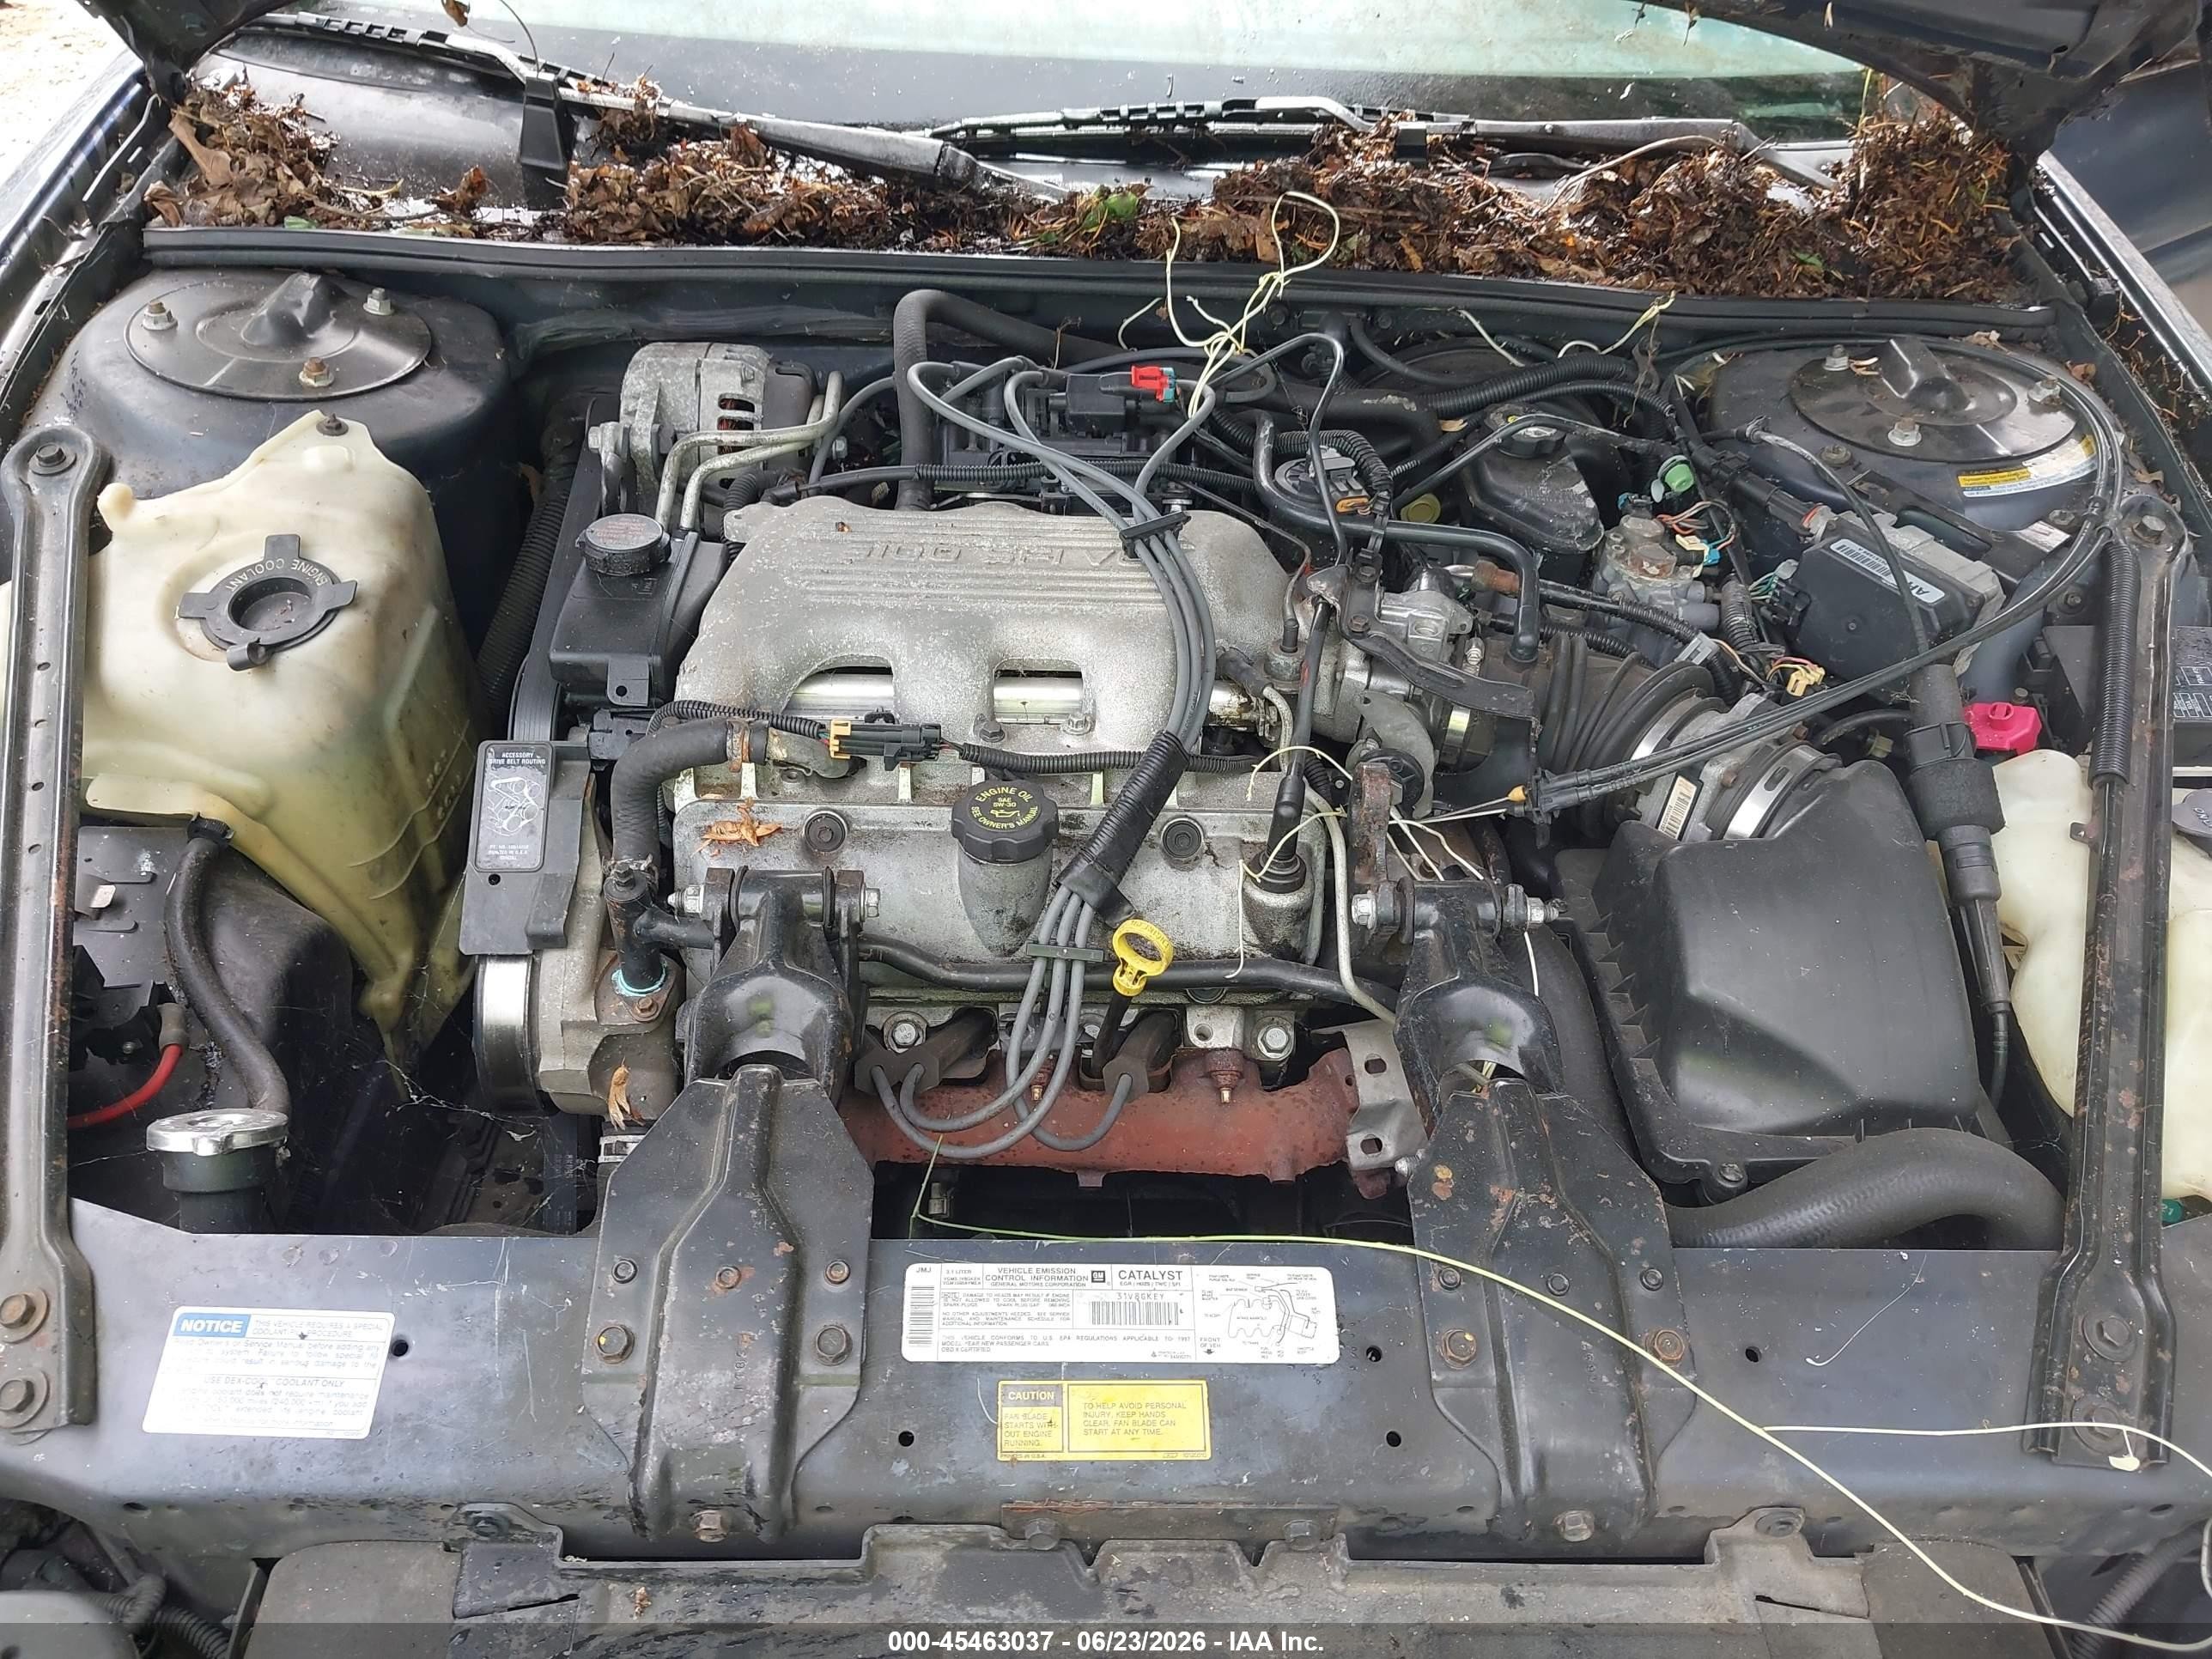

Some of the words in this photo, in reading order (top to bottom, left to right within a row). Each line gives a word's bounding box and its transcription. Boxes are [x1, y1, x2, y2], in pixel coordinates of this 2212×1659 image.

[224, 558, 284, 592] COOLANT
[290, 558, 330, 586] ENGINE
[975, 787, 1018, 802] ENGINE
[1018, 790, 1033, 802] OIL
[970, 805, 982, 818] SEE
[979, 816, 1016, 830] OWNER'S
[1016, 805, 1038, 827] MANUAL
[1118, 1269, 1183, 1280] CATALYST
[179, 1319, 244, 1334] NOTICE
[336, 1344, 364, 1352] adding
[276, 1378, 319, 1387] COOLANT
[321, 1379, 344, 1388] ONLY
[1008, 1391, 1054, 1401] CAUTION
